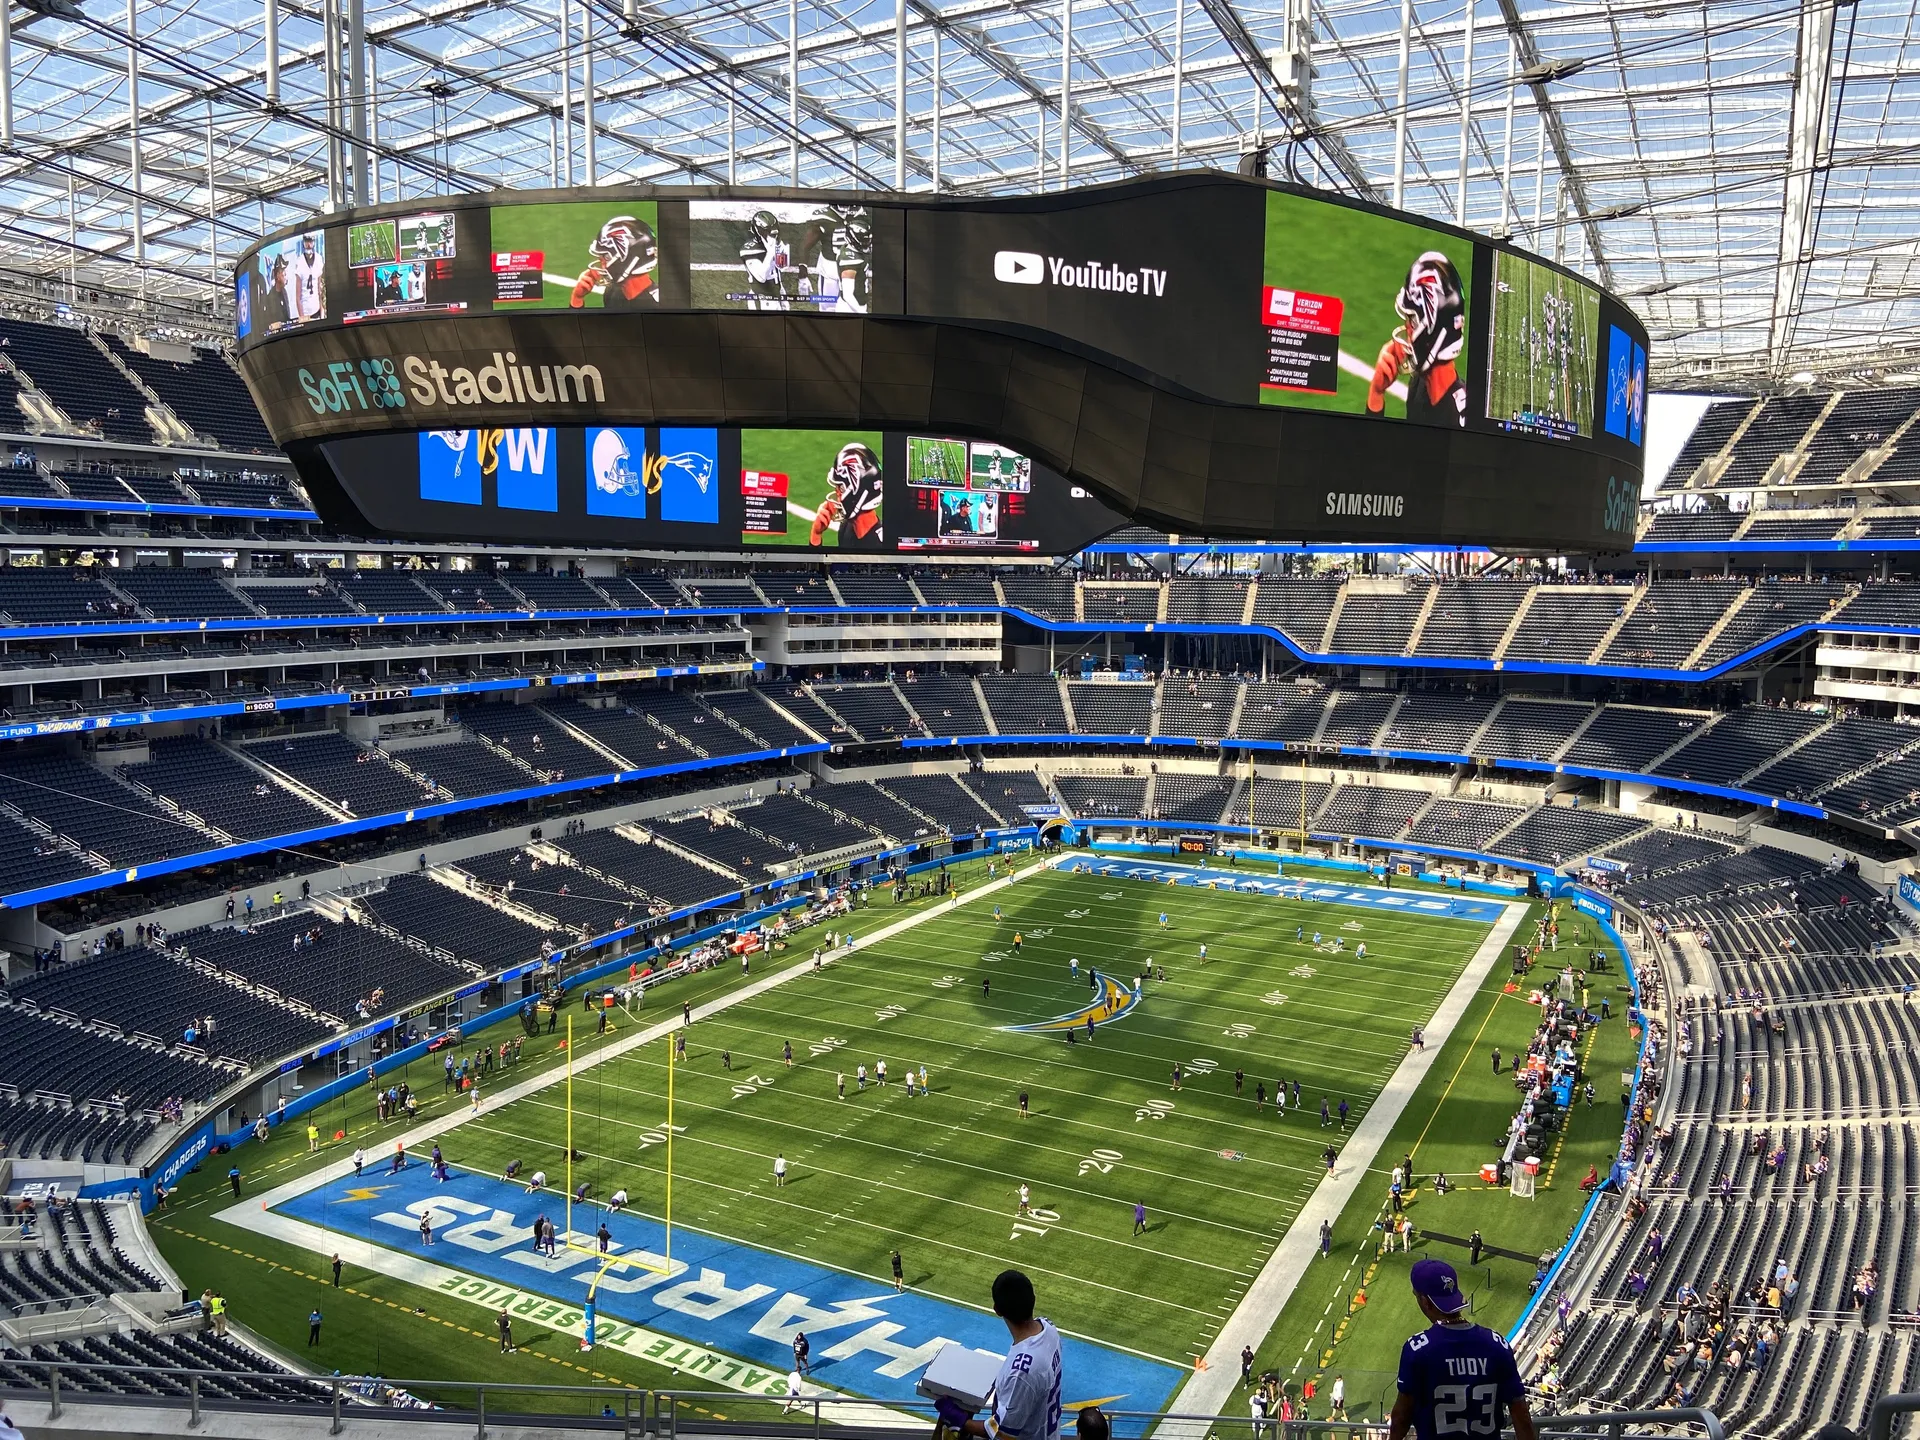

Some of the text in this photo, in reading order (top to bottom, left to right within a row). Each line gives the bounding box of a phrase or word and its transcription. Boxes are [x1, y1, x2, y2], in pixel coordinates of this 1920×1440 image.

[1048, 256, 1167, 297] YouTube TV
[1295, 306, 1318, 315] HALFTIME
[1297, 298, 1323, 309] VERIZON
[1271, 329, 1307, 339] MASON RUDOLPH
[1271, 348, 1331, 362] WASHINGTON FOOTBALL TEAM
[1297, 359, 1311, 367] START
[1269, 368, 1308, 378] JONATHAN TAYLOR
[1269, 375, 1282, 383] CAN'T
[1288, 378, 1308, 386] STOPPED
[298, 351, 606, 415] SoFi Stadium
[642, 449, 668, 495] VS
[1325, 491, 1404, 517] SAMSUNG
[253, 702, 275, 710] 90:00
[10, 727, 33, 737] FUND
[36, 720, 85, 734] TOUCHDOWNS
[84, 719, 95, 729] FOR
[96, 717, 114, 728] TURF
[1181, 841, 1204, 852] 90:00
[831, 861, 850, 872] ANGELES
[1589, 858, 1622, 870] #BOLTU
[1197, 877, 1453, 911] ANGELES
[1578, 897, 1607, 916] #BOLTUP
[519, 961, 544, 975] #BOLTU
[408, 980, 491, 1019] LOS ANGELES CHARGERS
[1259, 992, 1290, 1006] 40
[875, 1003, 908, 1018] 40
[1222, 1023, 1257, 1039] 50
[808, 1036, 848, 1053] 30
[1184, 1058, 1219, 1075] 40
[731, 1074, 775, 1095] 20
[1135, 1099, 1176, 1120] 30
[638, 1121, 689, 1144] 10
[164, 1135, 207, 1183] CHARGERS
[1078, 1148, 1124, 1173] 20
[1011, 1208, 1061, 1237] 10
[372, 1195, 1008, 1406] HARGERS
[438, 1274, 585, 1328] SERVICE
[642, 1338, 791, 1397] SALUTE
[1011, 1352, 1034, 1374] 22
[1445, 1357, 1488, 1376] TUDY
[1434, 1383, 1498, 1436] 23
